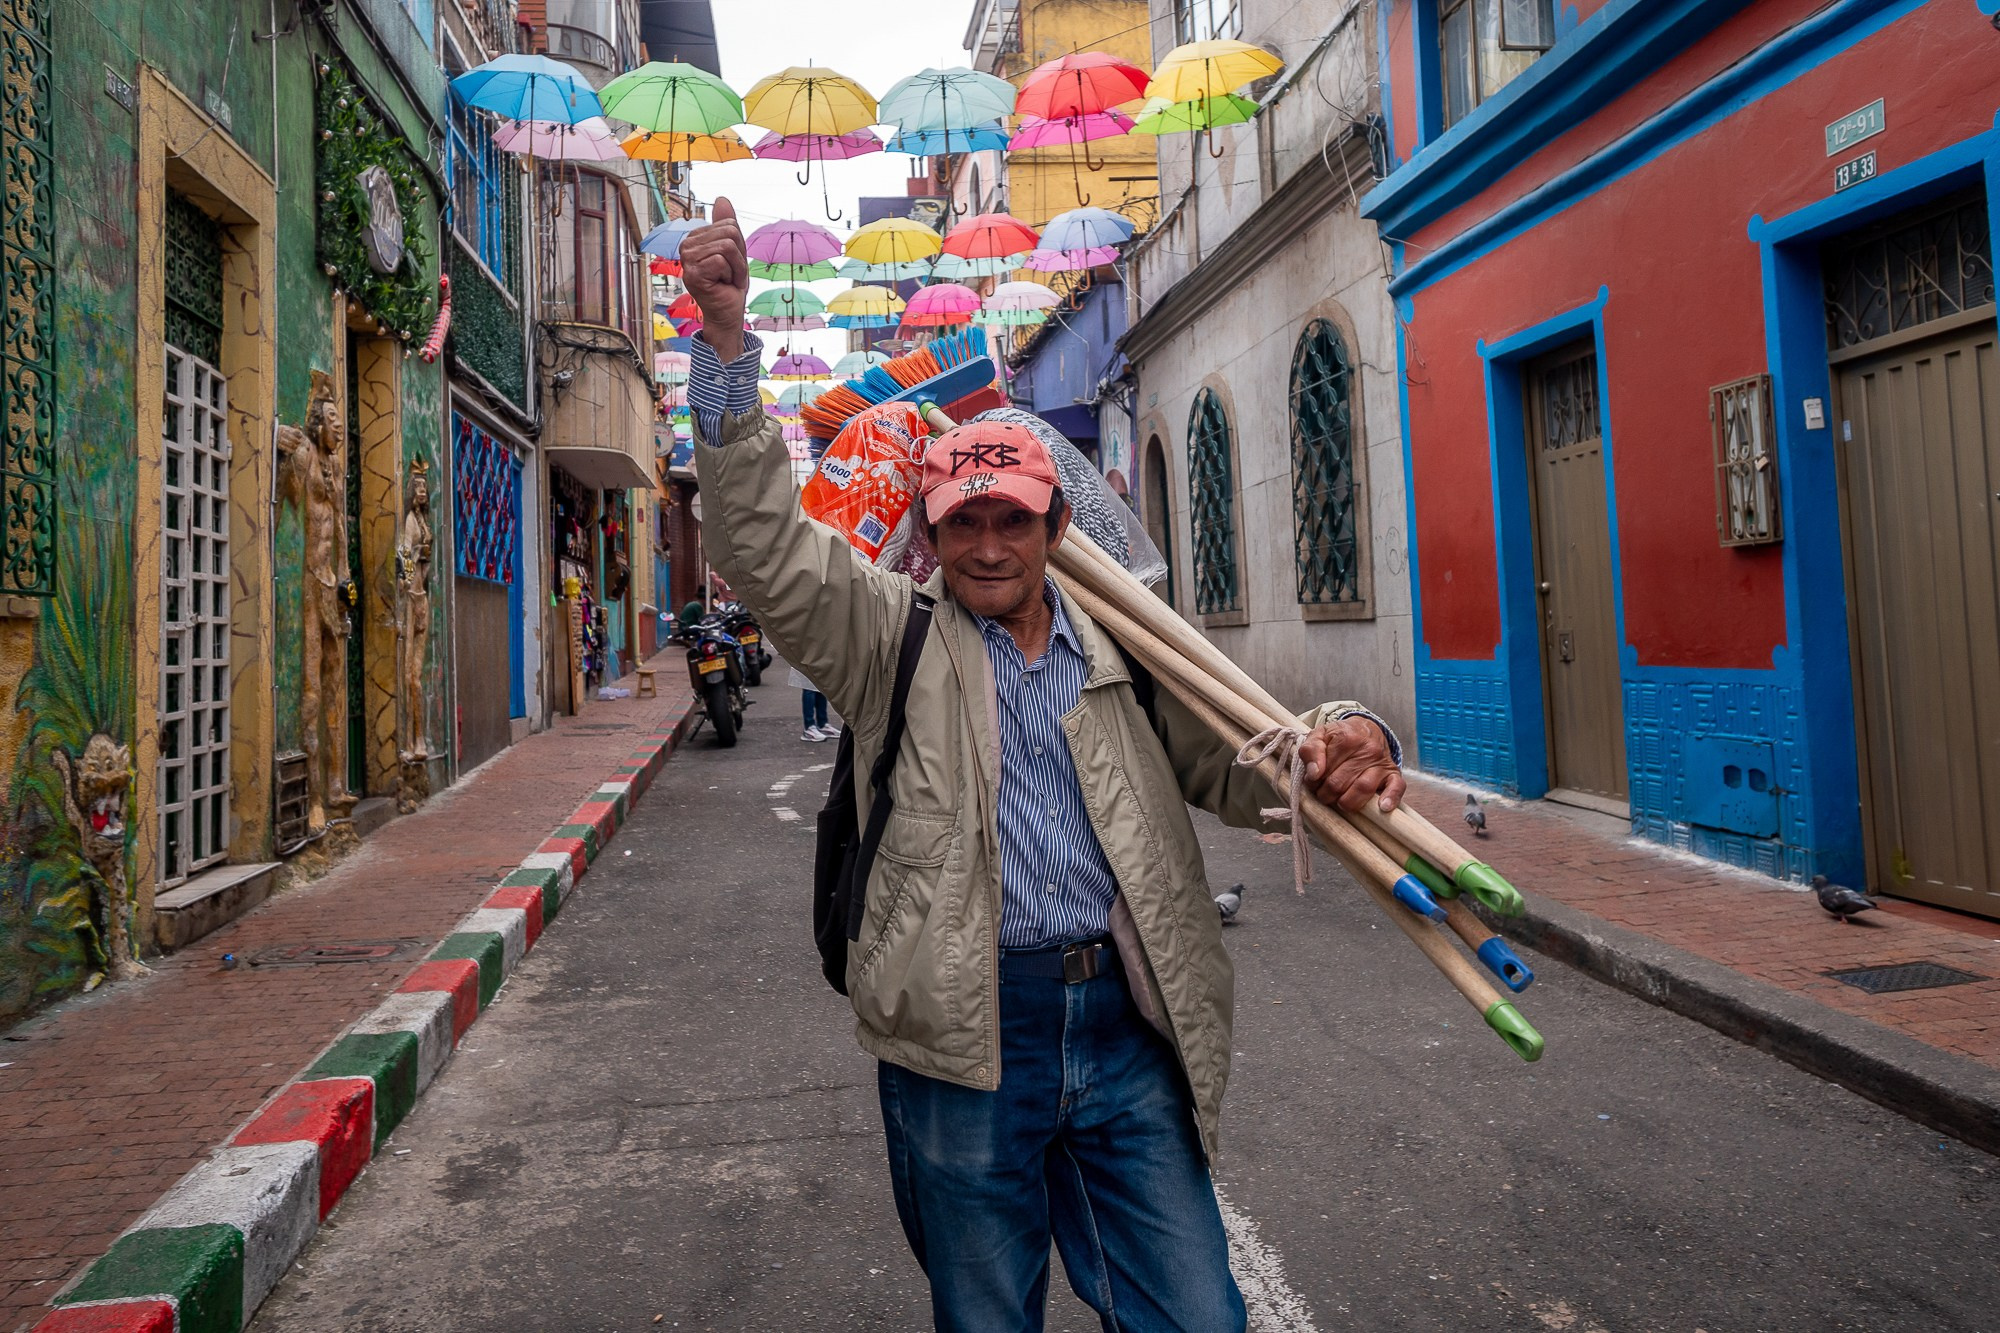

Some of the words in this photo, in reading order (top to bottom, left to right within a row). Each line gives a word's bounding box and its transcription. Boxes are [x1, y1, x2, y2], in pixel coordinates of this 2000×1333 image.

[1838, 165, 1849, 187] 13
[1860, 155, 1873, 178] 33
[825, 462, 851, 479] 1000
